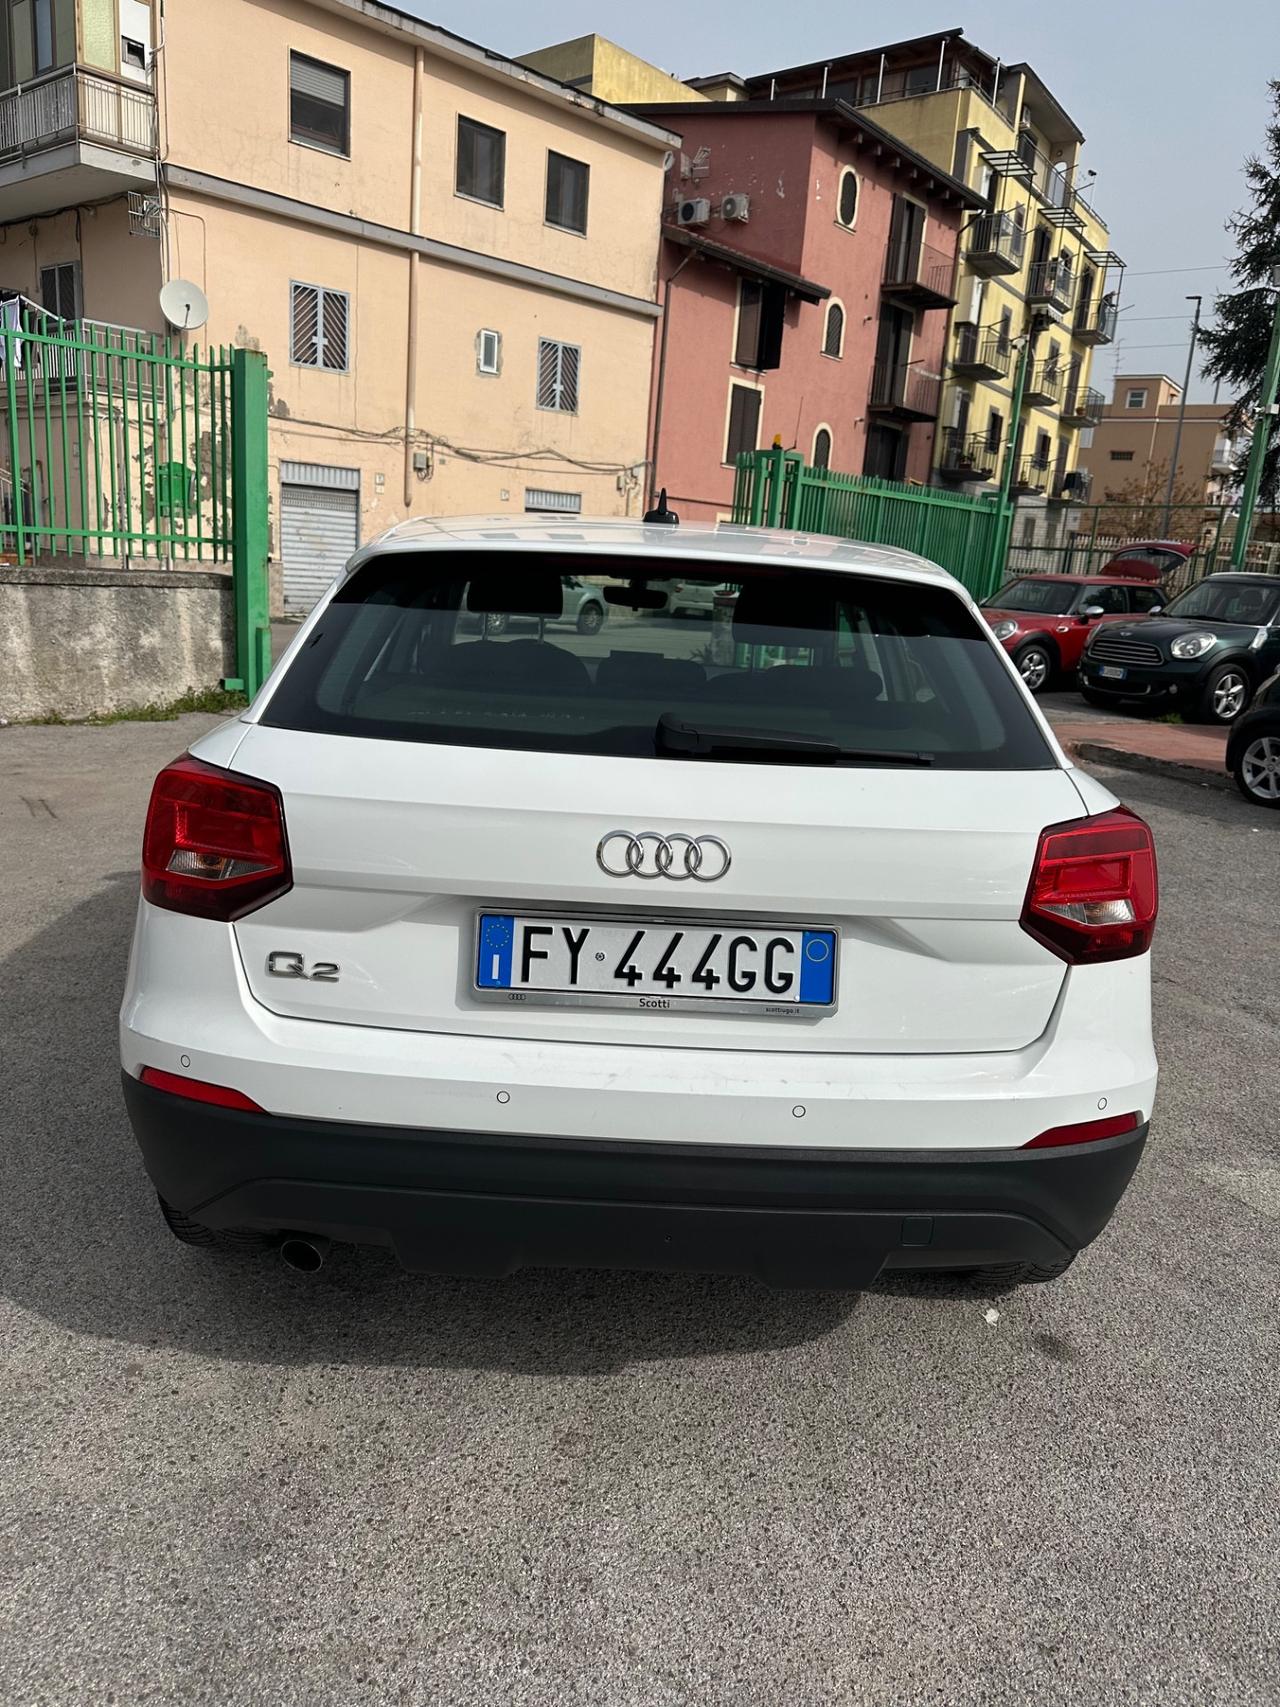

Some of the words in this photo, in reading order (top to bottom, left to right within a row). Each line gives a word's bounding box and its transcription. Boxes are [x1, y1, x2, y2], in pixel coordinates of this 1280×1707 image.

[266, 951, 340, 983] Q2
[491, 954, 500, 980] I
[521, 925, 590, 985] FY
[614, 930, 795, 994] 444GG
[638, 998, 671, 1009] Scotti
